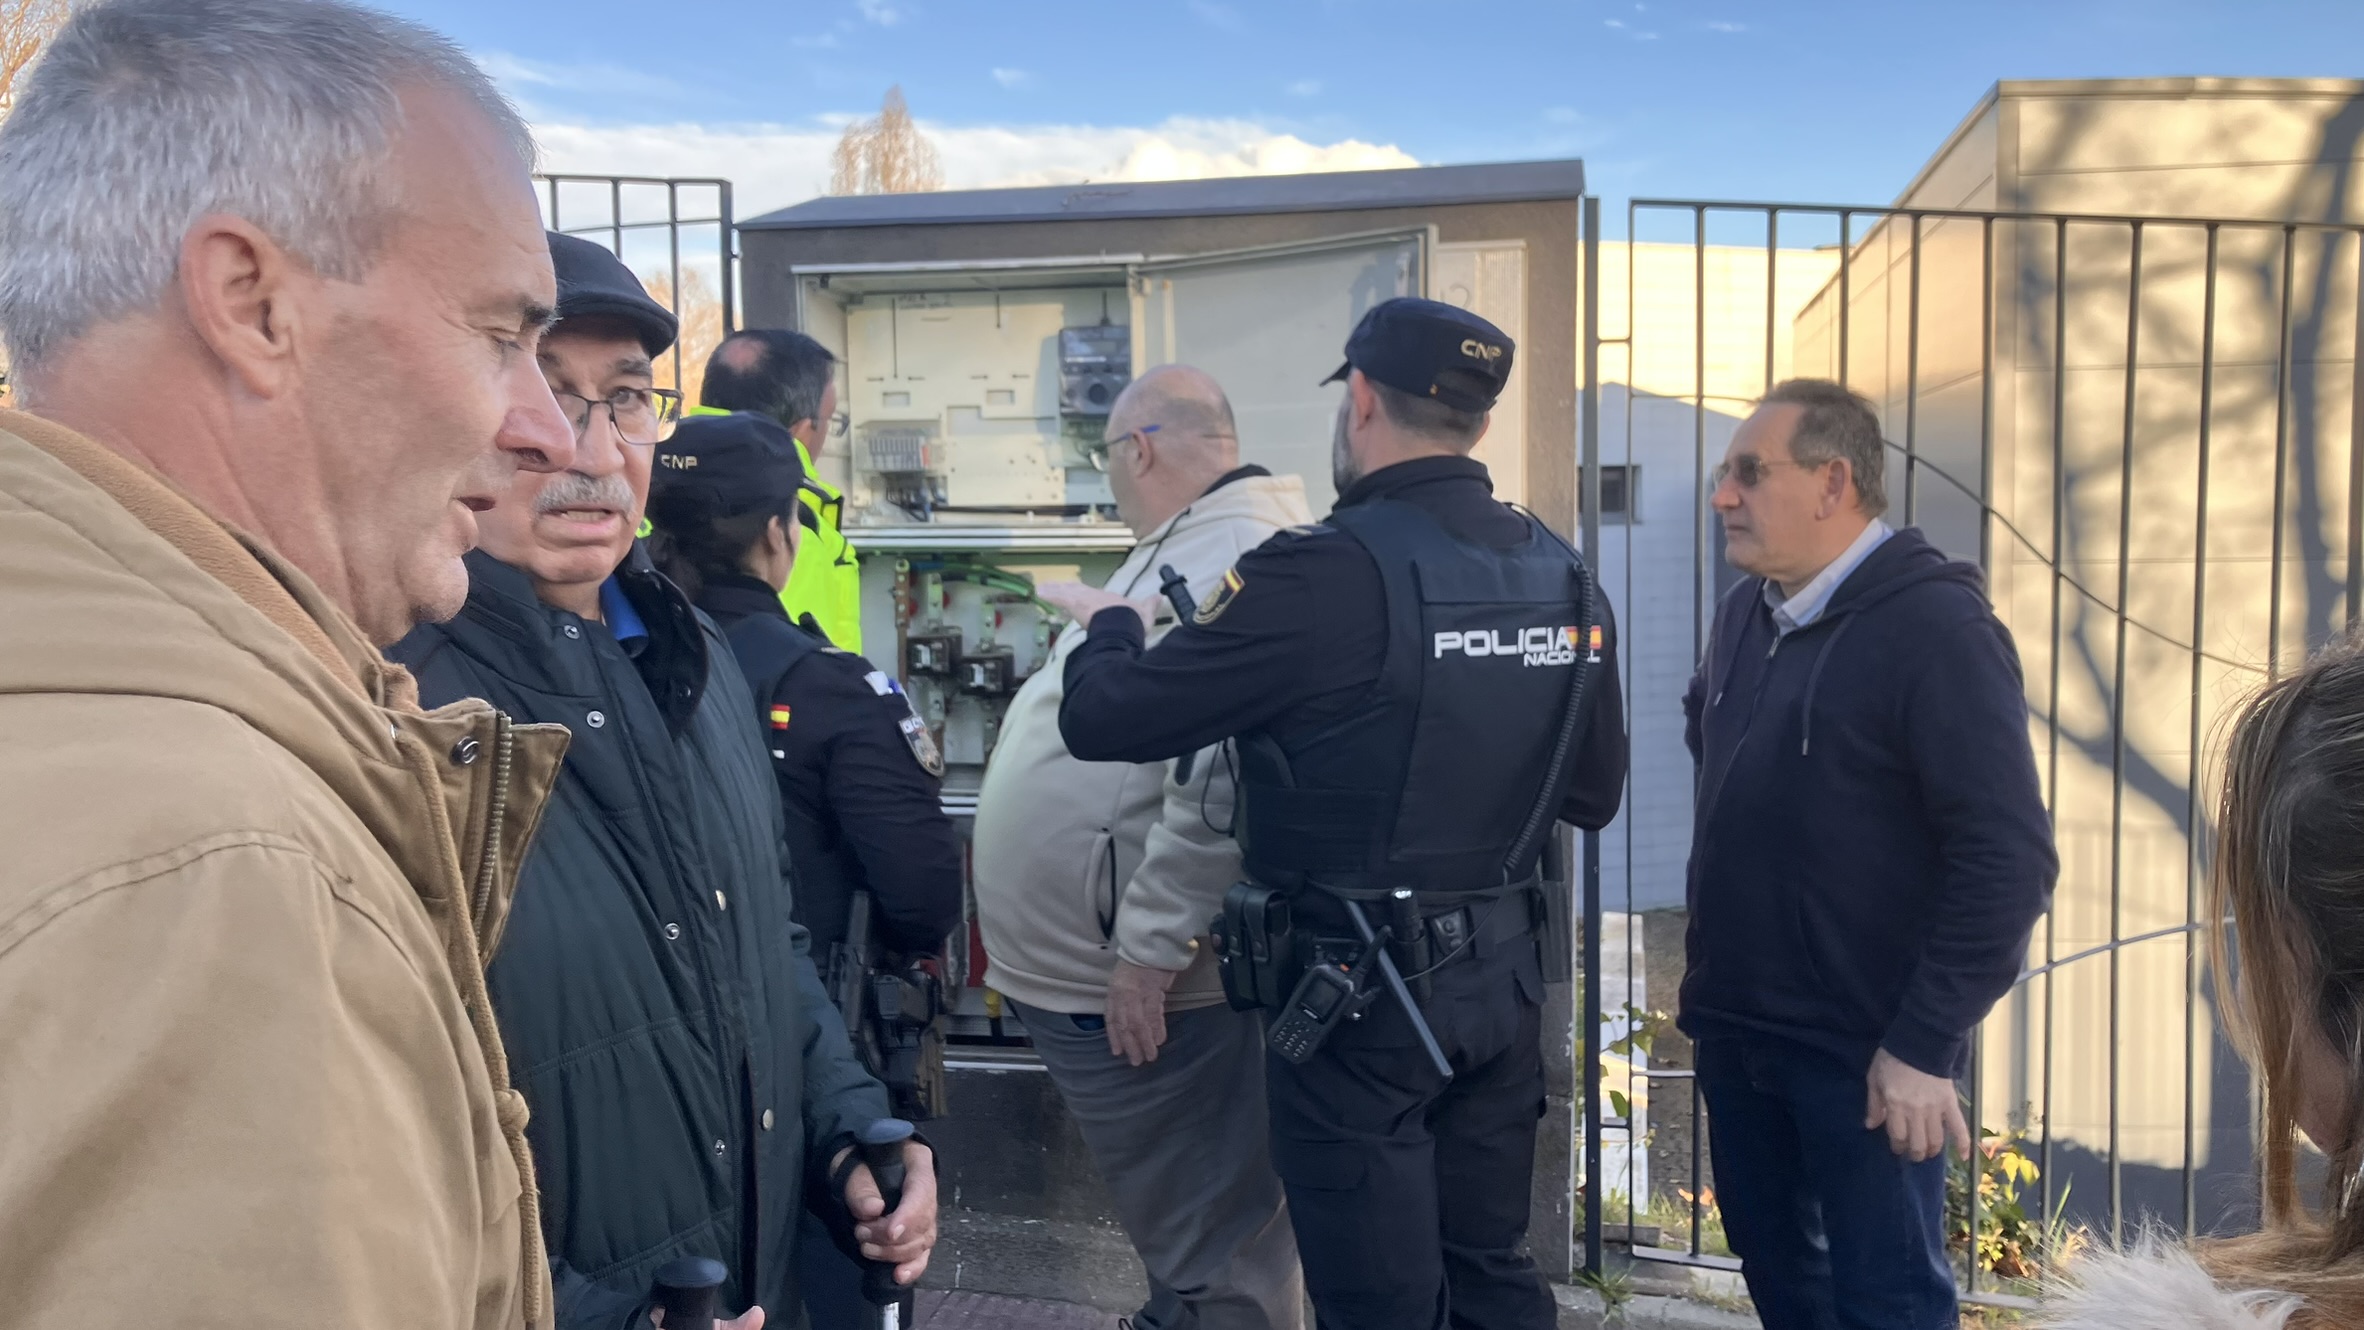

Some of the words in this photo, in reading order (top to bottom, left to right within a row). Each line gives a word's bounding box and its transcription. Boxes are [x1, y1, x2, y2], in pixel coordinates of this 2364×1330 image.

[1461, 339, 1502, 362] CNP
[661, 454, 698, 470] CNP
[1434, 626, 1573, 659] POLICIA
[1523, 649, 1601, 667] NACIOL
